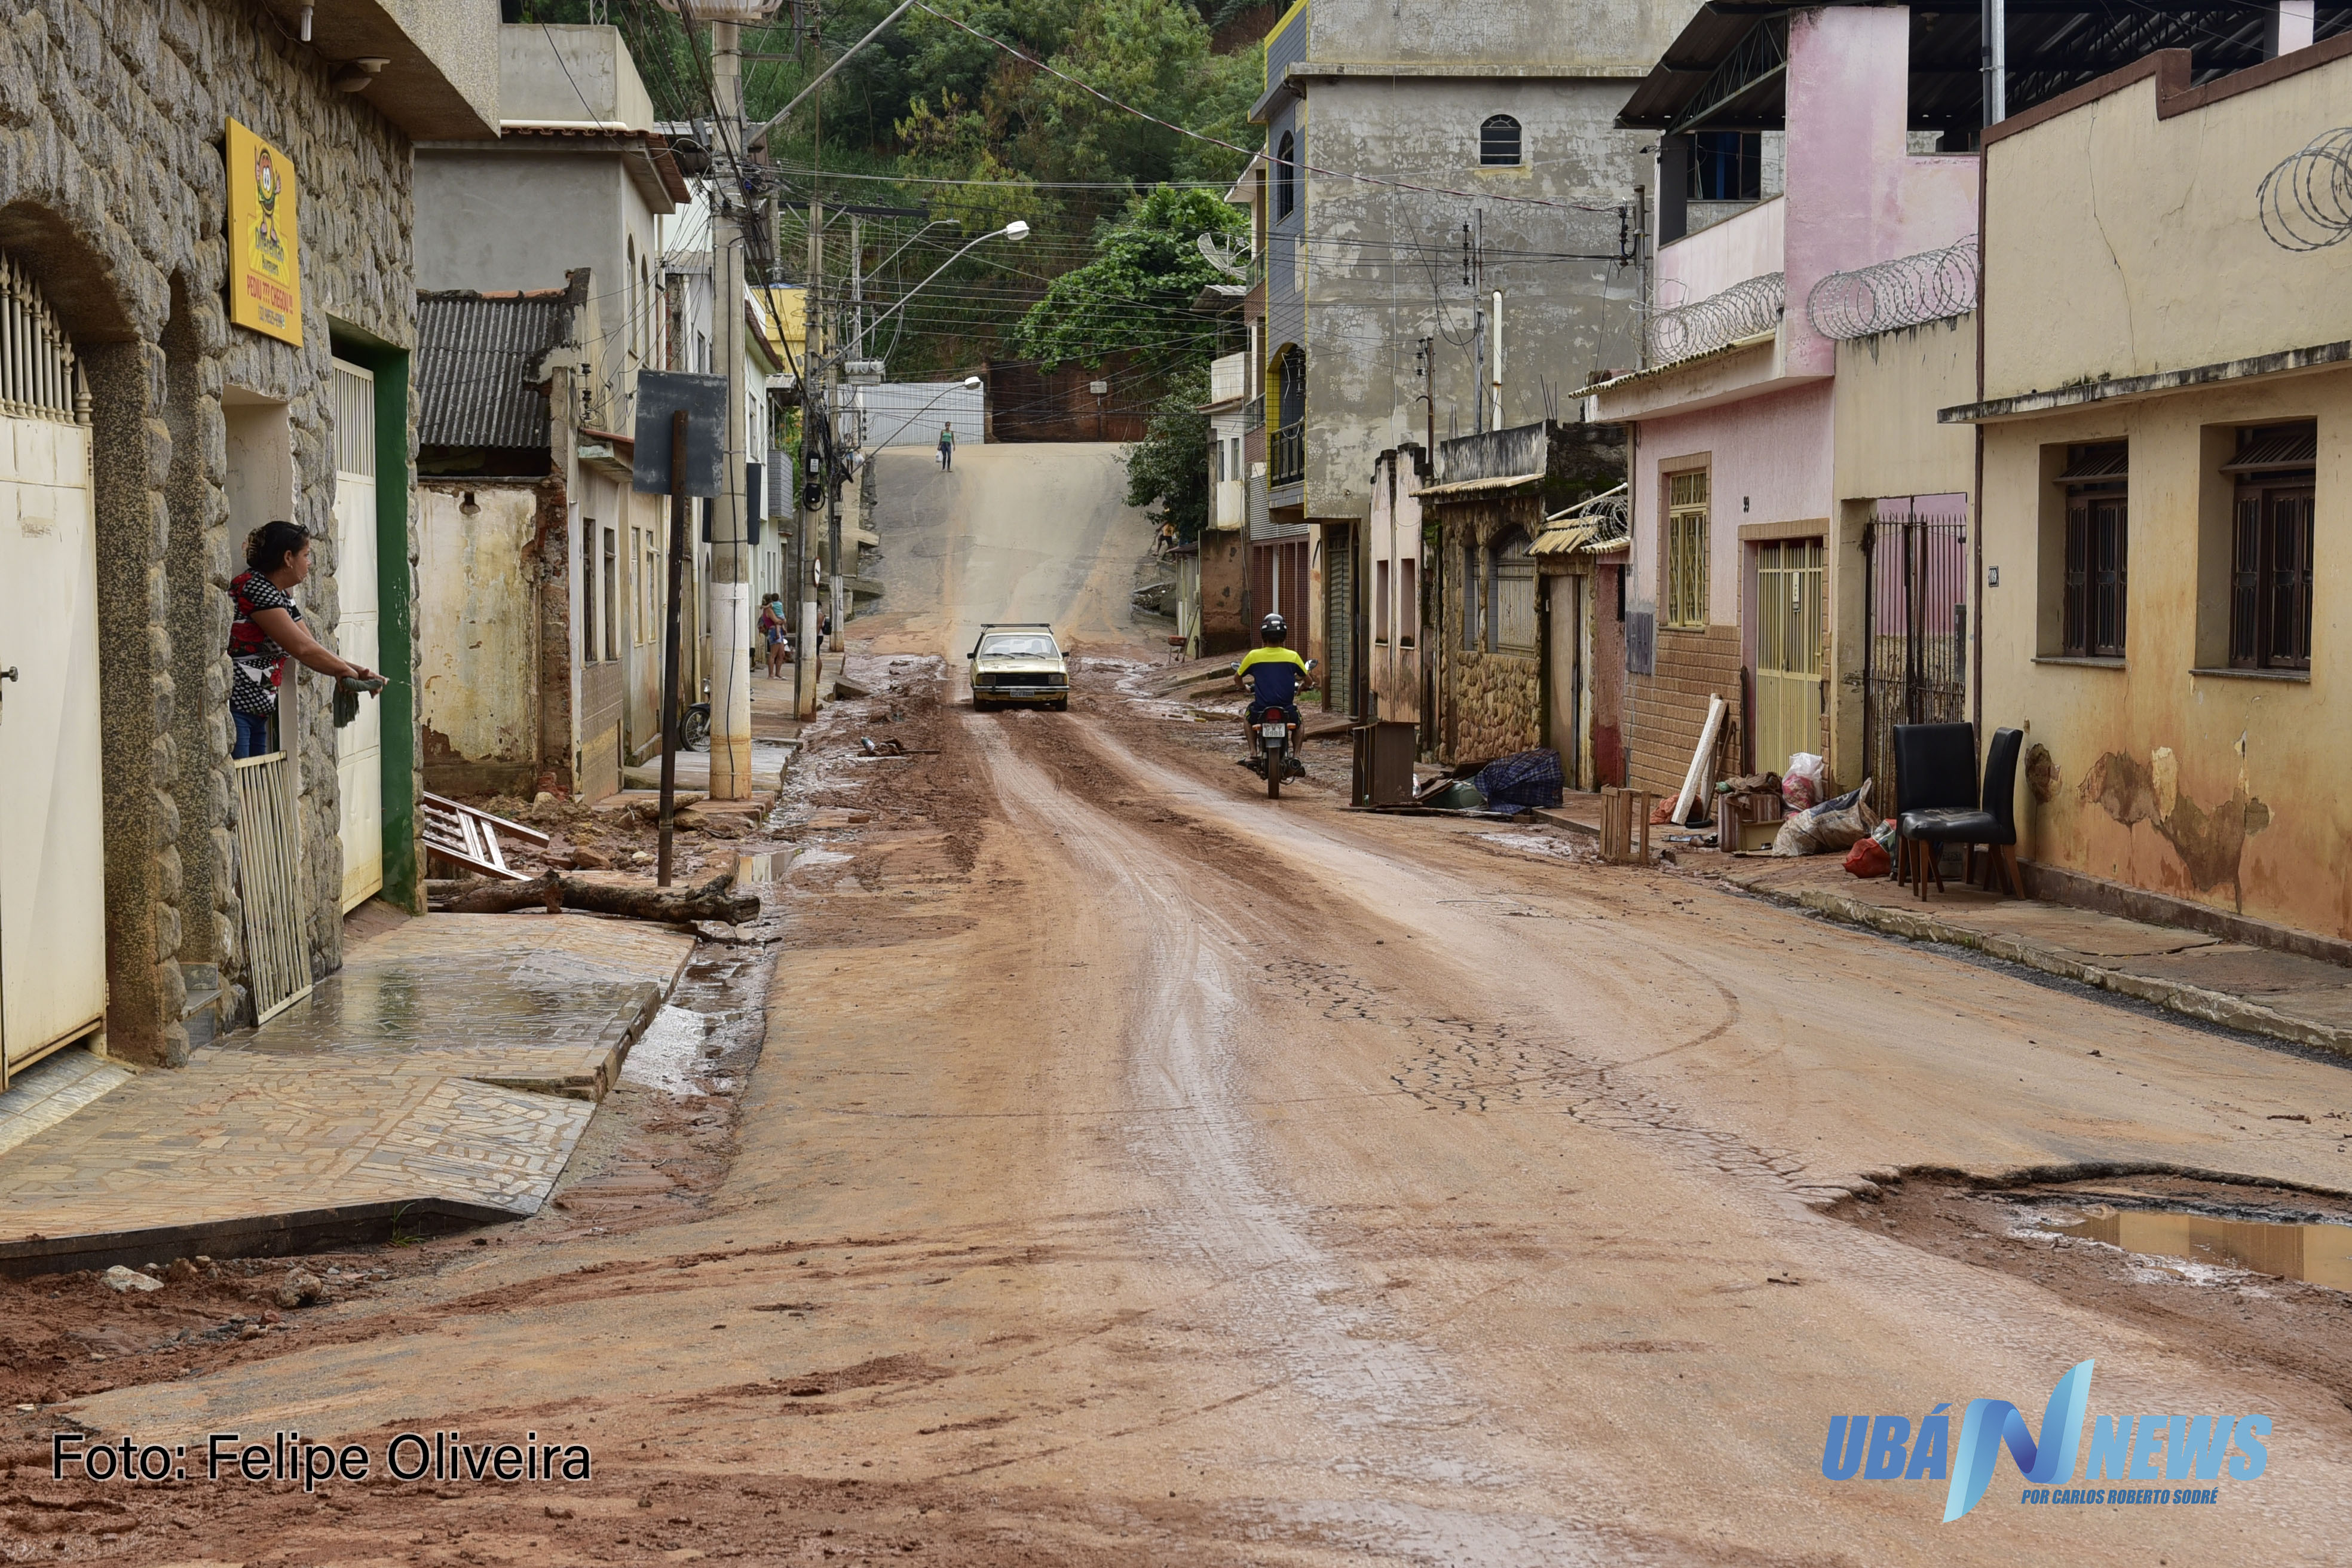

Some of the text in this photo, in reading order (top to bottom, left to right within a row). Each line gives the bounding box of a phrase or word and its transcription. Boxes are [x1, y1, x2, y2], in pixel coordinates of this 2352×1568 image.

[247, 274, 262, 301] PEDIU
[271, 285, 289, 313] CHEGOU
[1742, 495, 1750, 513] 99
